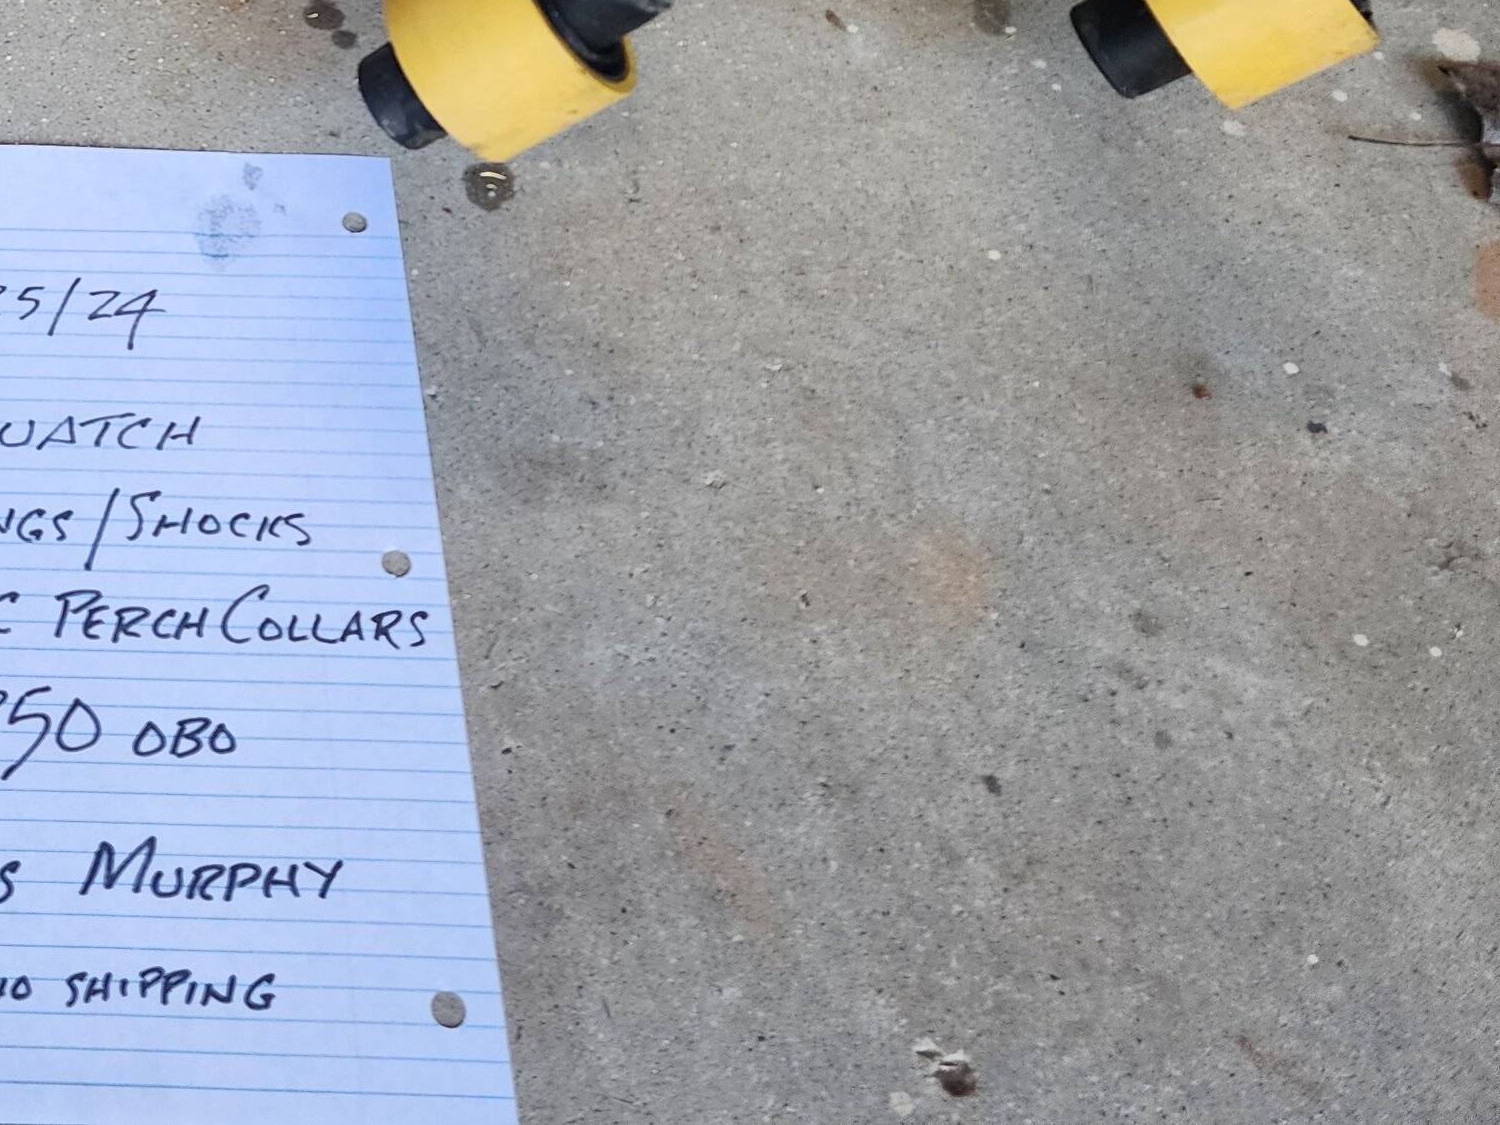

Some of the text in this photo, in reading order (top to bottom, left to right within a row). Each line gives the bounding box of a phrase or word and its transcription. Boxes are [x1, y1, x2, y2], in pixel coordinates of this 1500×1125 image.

[54, 589, 209, 644] PERCH
[220, 584, 429, 649] COLLARS
[78, 836, 343, 902] MURPHY
[66, 967, 275, 1011] SHIPPING
